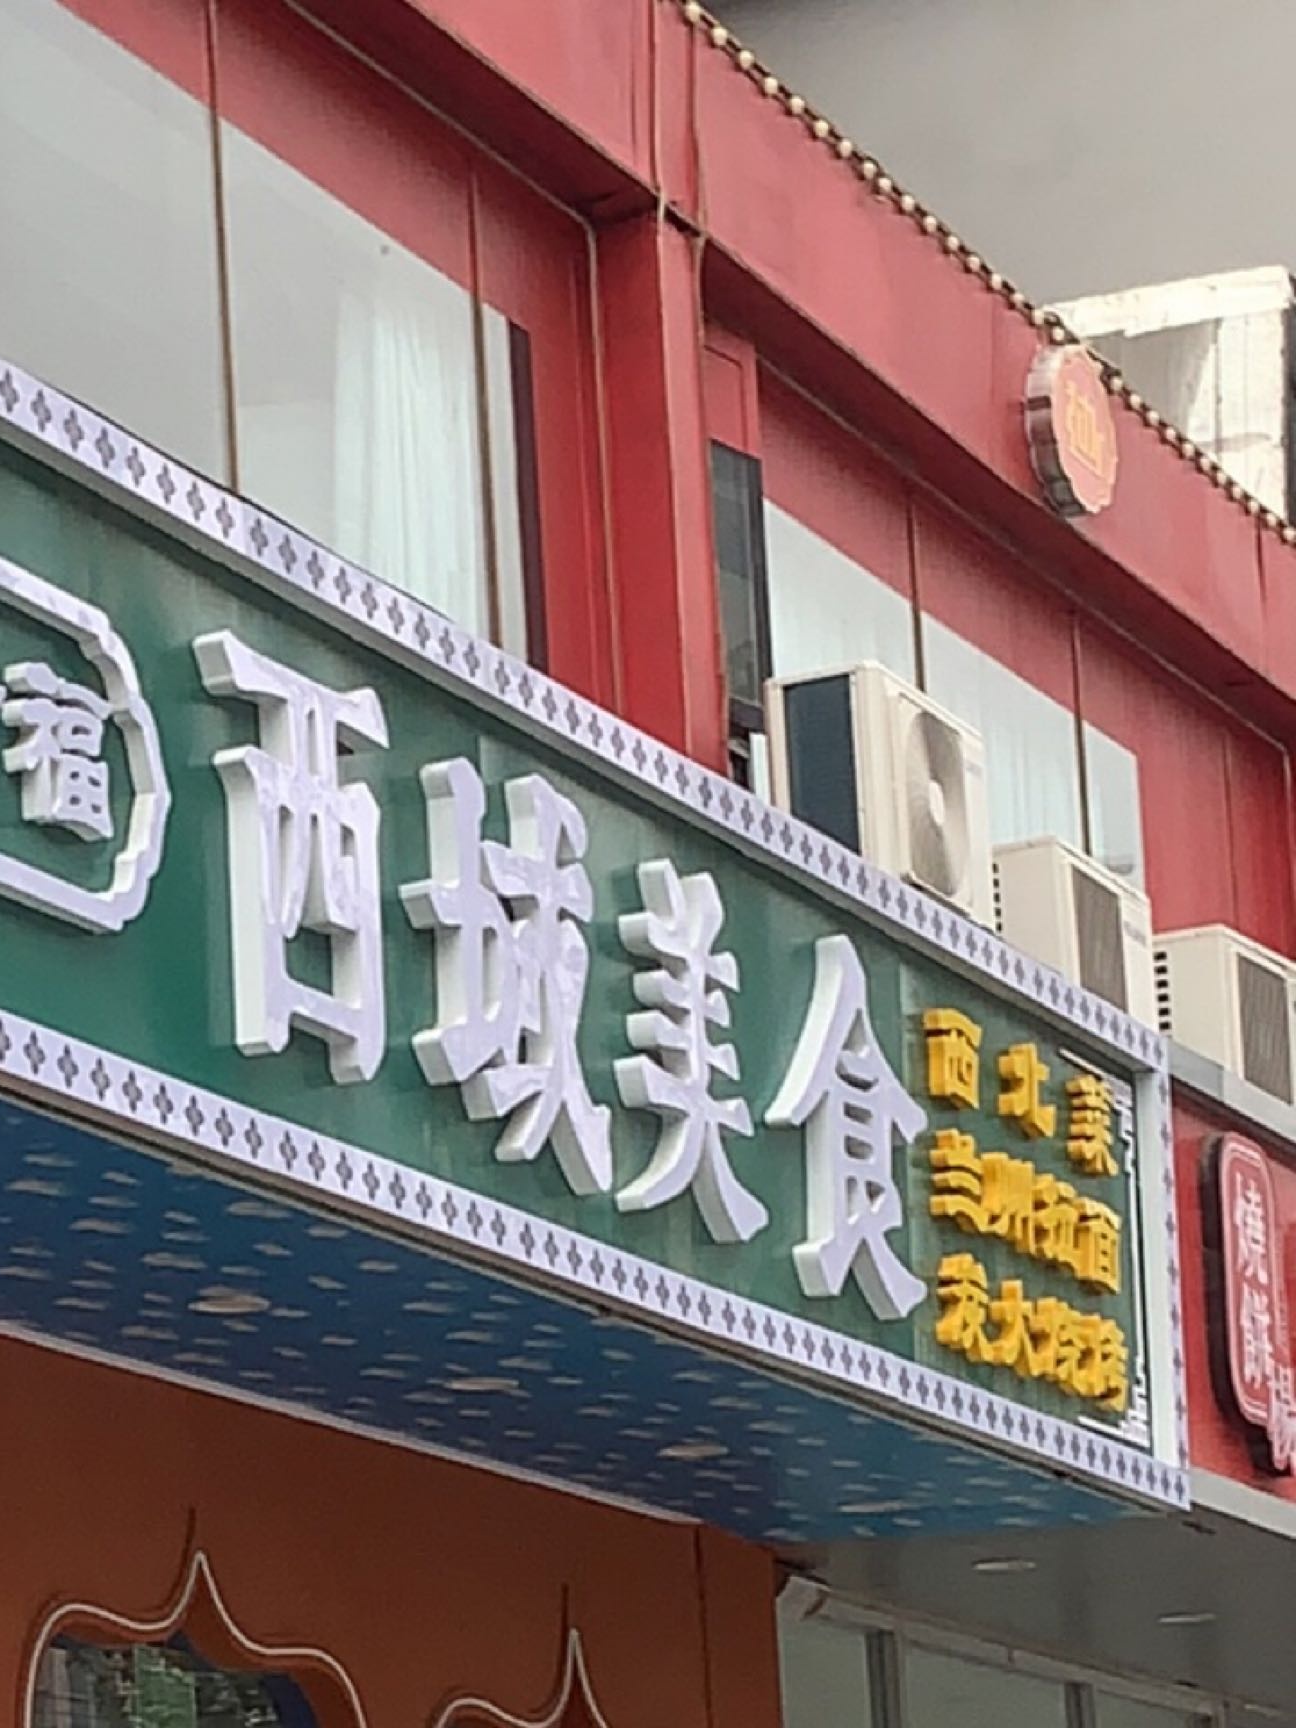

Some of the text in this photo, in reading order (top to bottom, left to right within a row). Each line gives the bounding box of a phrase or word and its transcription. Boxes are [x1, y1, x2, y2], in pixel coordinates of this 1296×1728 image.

[193, 630, 929, 1322] 西域美食
[922, 1007, 1119, 1177] 西北菜
[929, 1127, 1123, 1295] 兰州拉面
